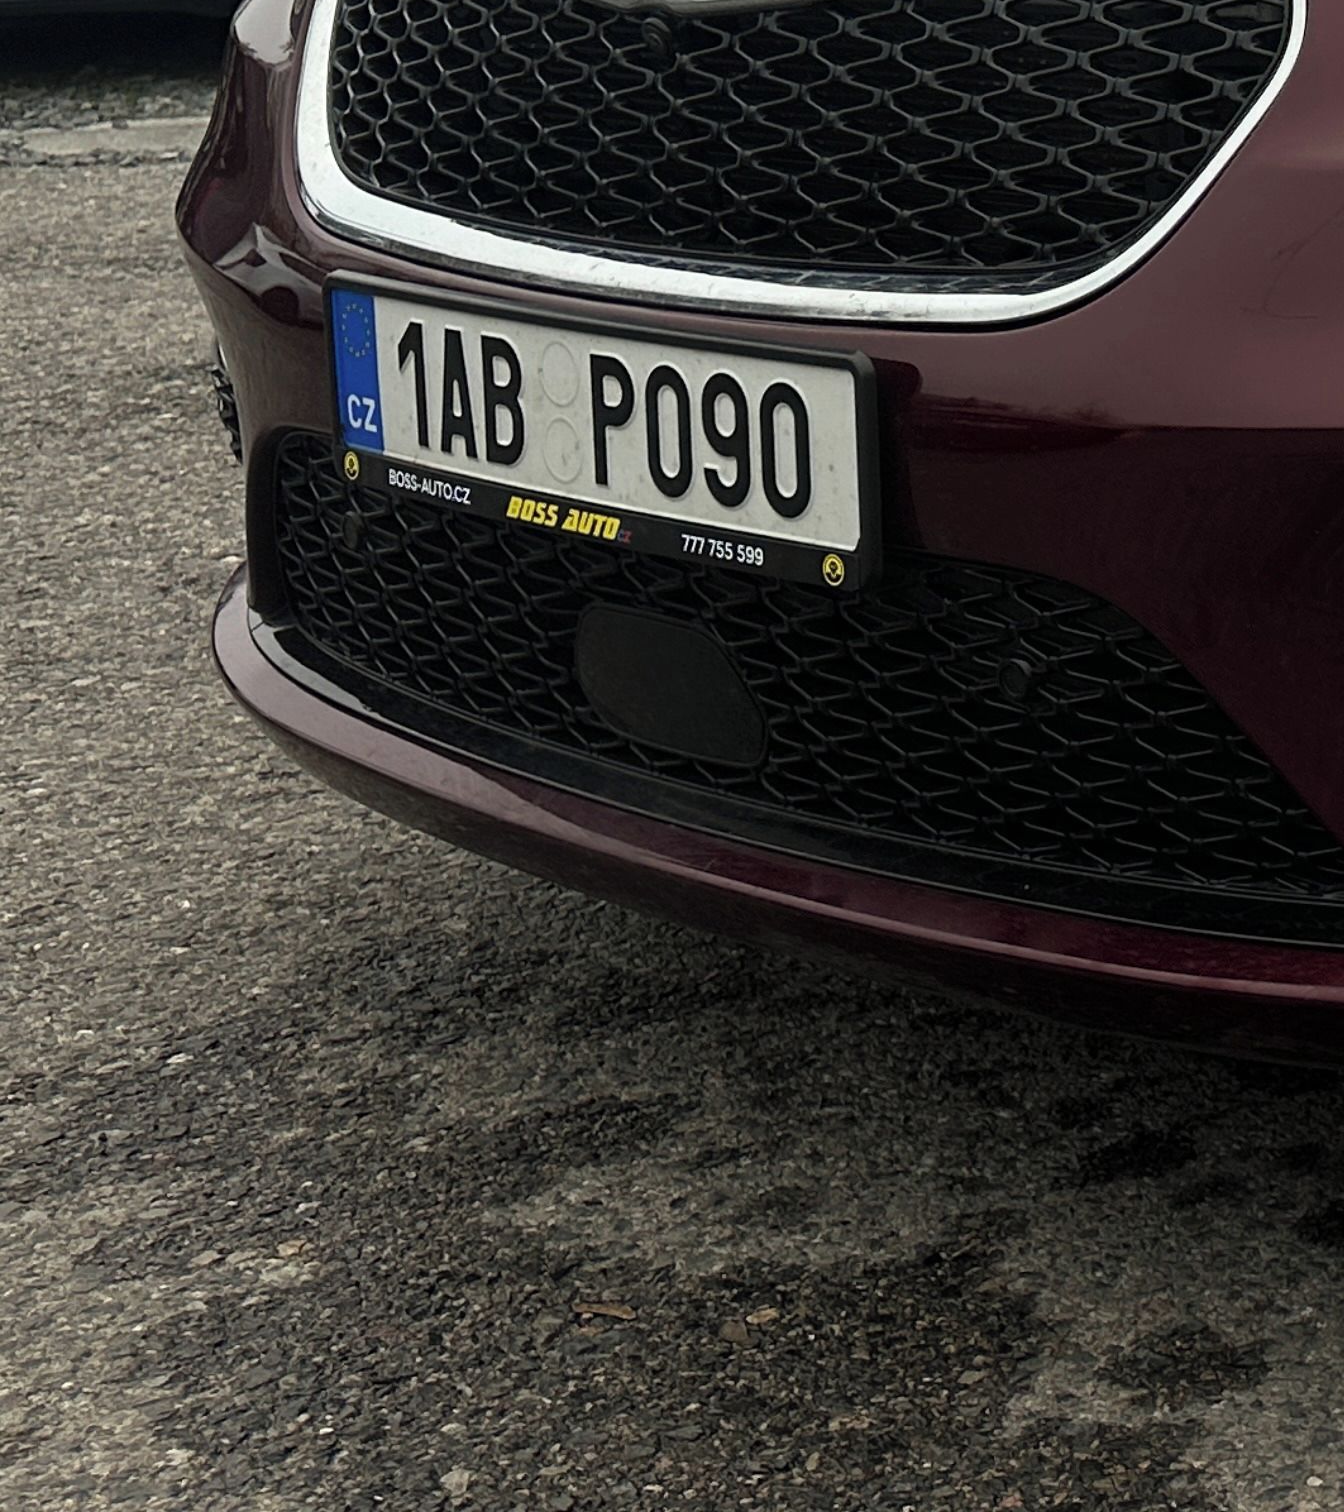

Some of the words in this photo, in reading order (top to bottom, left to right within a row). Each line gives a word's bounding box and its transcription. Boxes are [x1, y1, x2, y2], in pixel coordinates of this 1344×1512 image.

[346, 393, 378, 433] CZ
[397, 320, 525, 467] 1AB
[589, 352, 812, 519] P090
[389, 468, 471, 505] BOSS-AUTO.CZ
[506, 496, 559, 527] BOSS
[561, 508, 621, 540] AUTO
[681, 534, 705, 555] 777
[708, 538, 733, 560] 755
[736, 543, 764, 566] 599
